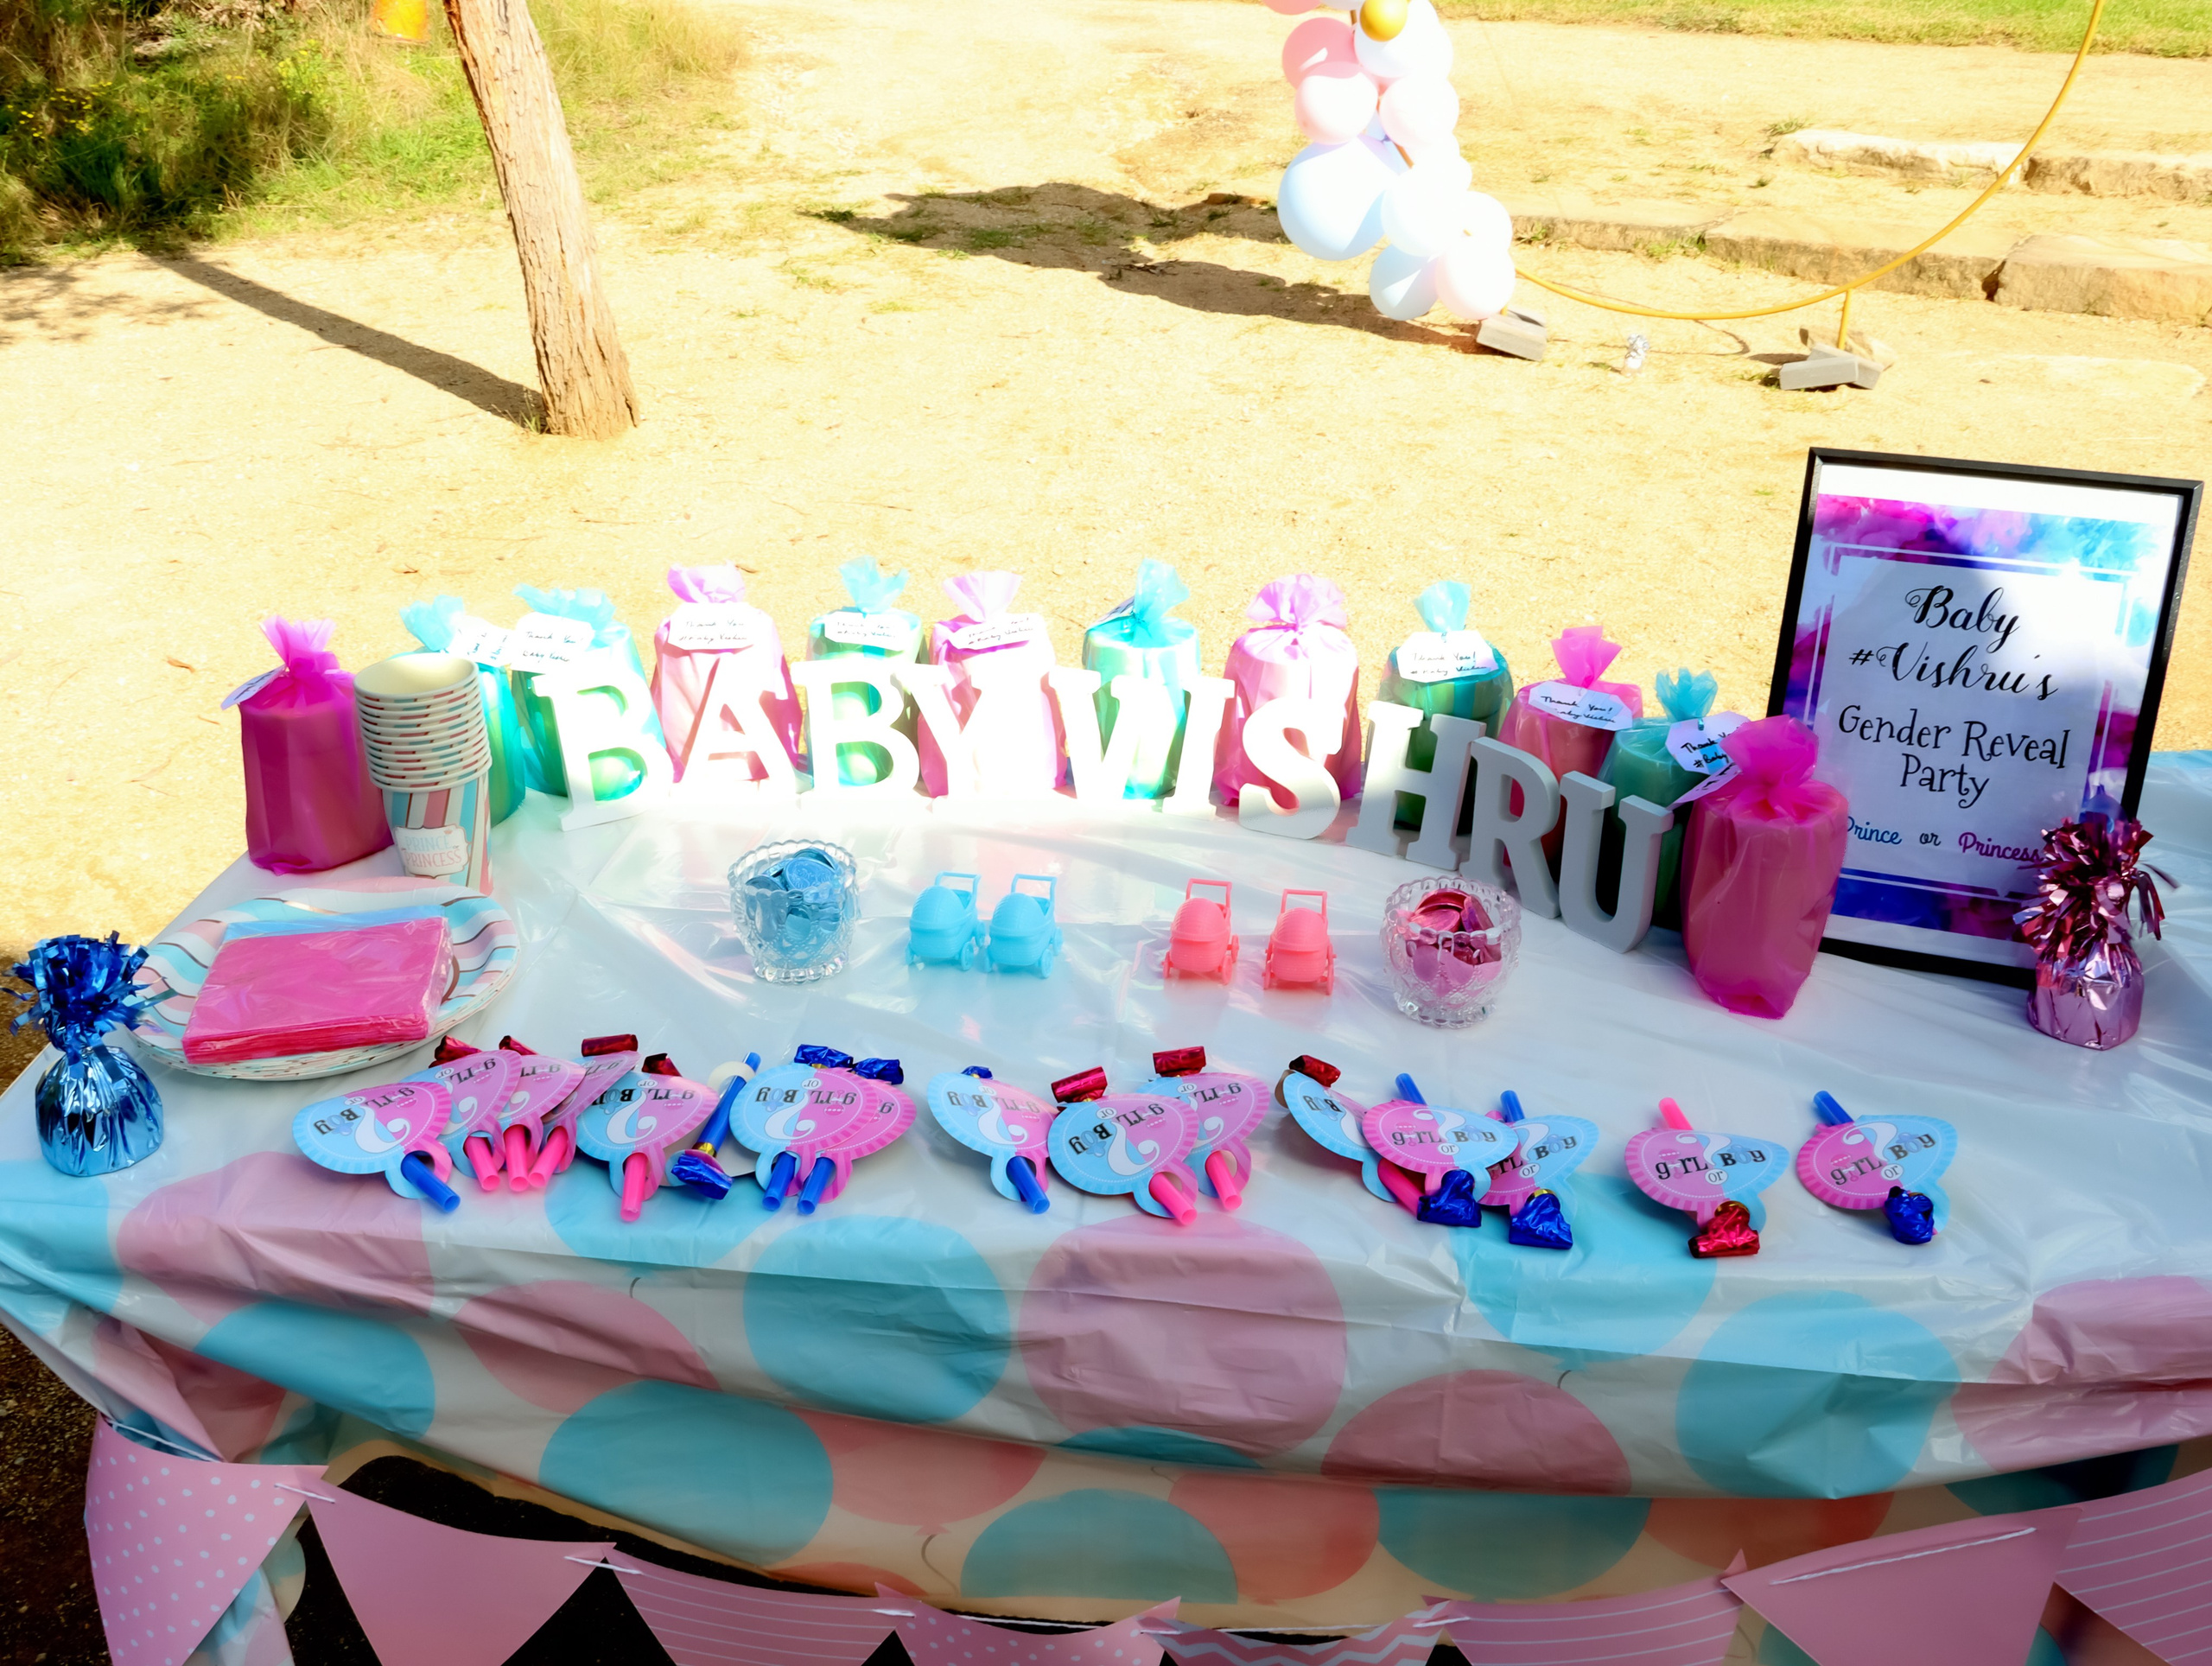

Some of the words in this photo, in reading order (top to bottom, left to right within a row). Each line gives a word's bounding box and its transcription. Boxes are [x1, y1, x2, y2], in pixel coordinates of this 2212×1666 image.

[1904, 584, 2020, 653] Baby
[1541, 696, 1581, 708] Thank
[531, 658, 1033, 831] BABY
[1681, 737, 1719, 754] Thank
[1838, 704, 1953, 751] Gender
[1962, 721, 2071, 769] Reveal
[1900, 754, 1990, 810] Party
[404, 835, 449, 852] PRINCE
[404, 849, 462, 868] PRINCESS
[1918, 832, 1942, 847] or
[1958, 831, 2044, 863] Princess
